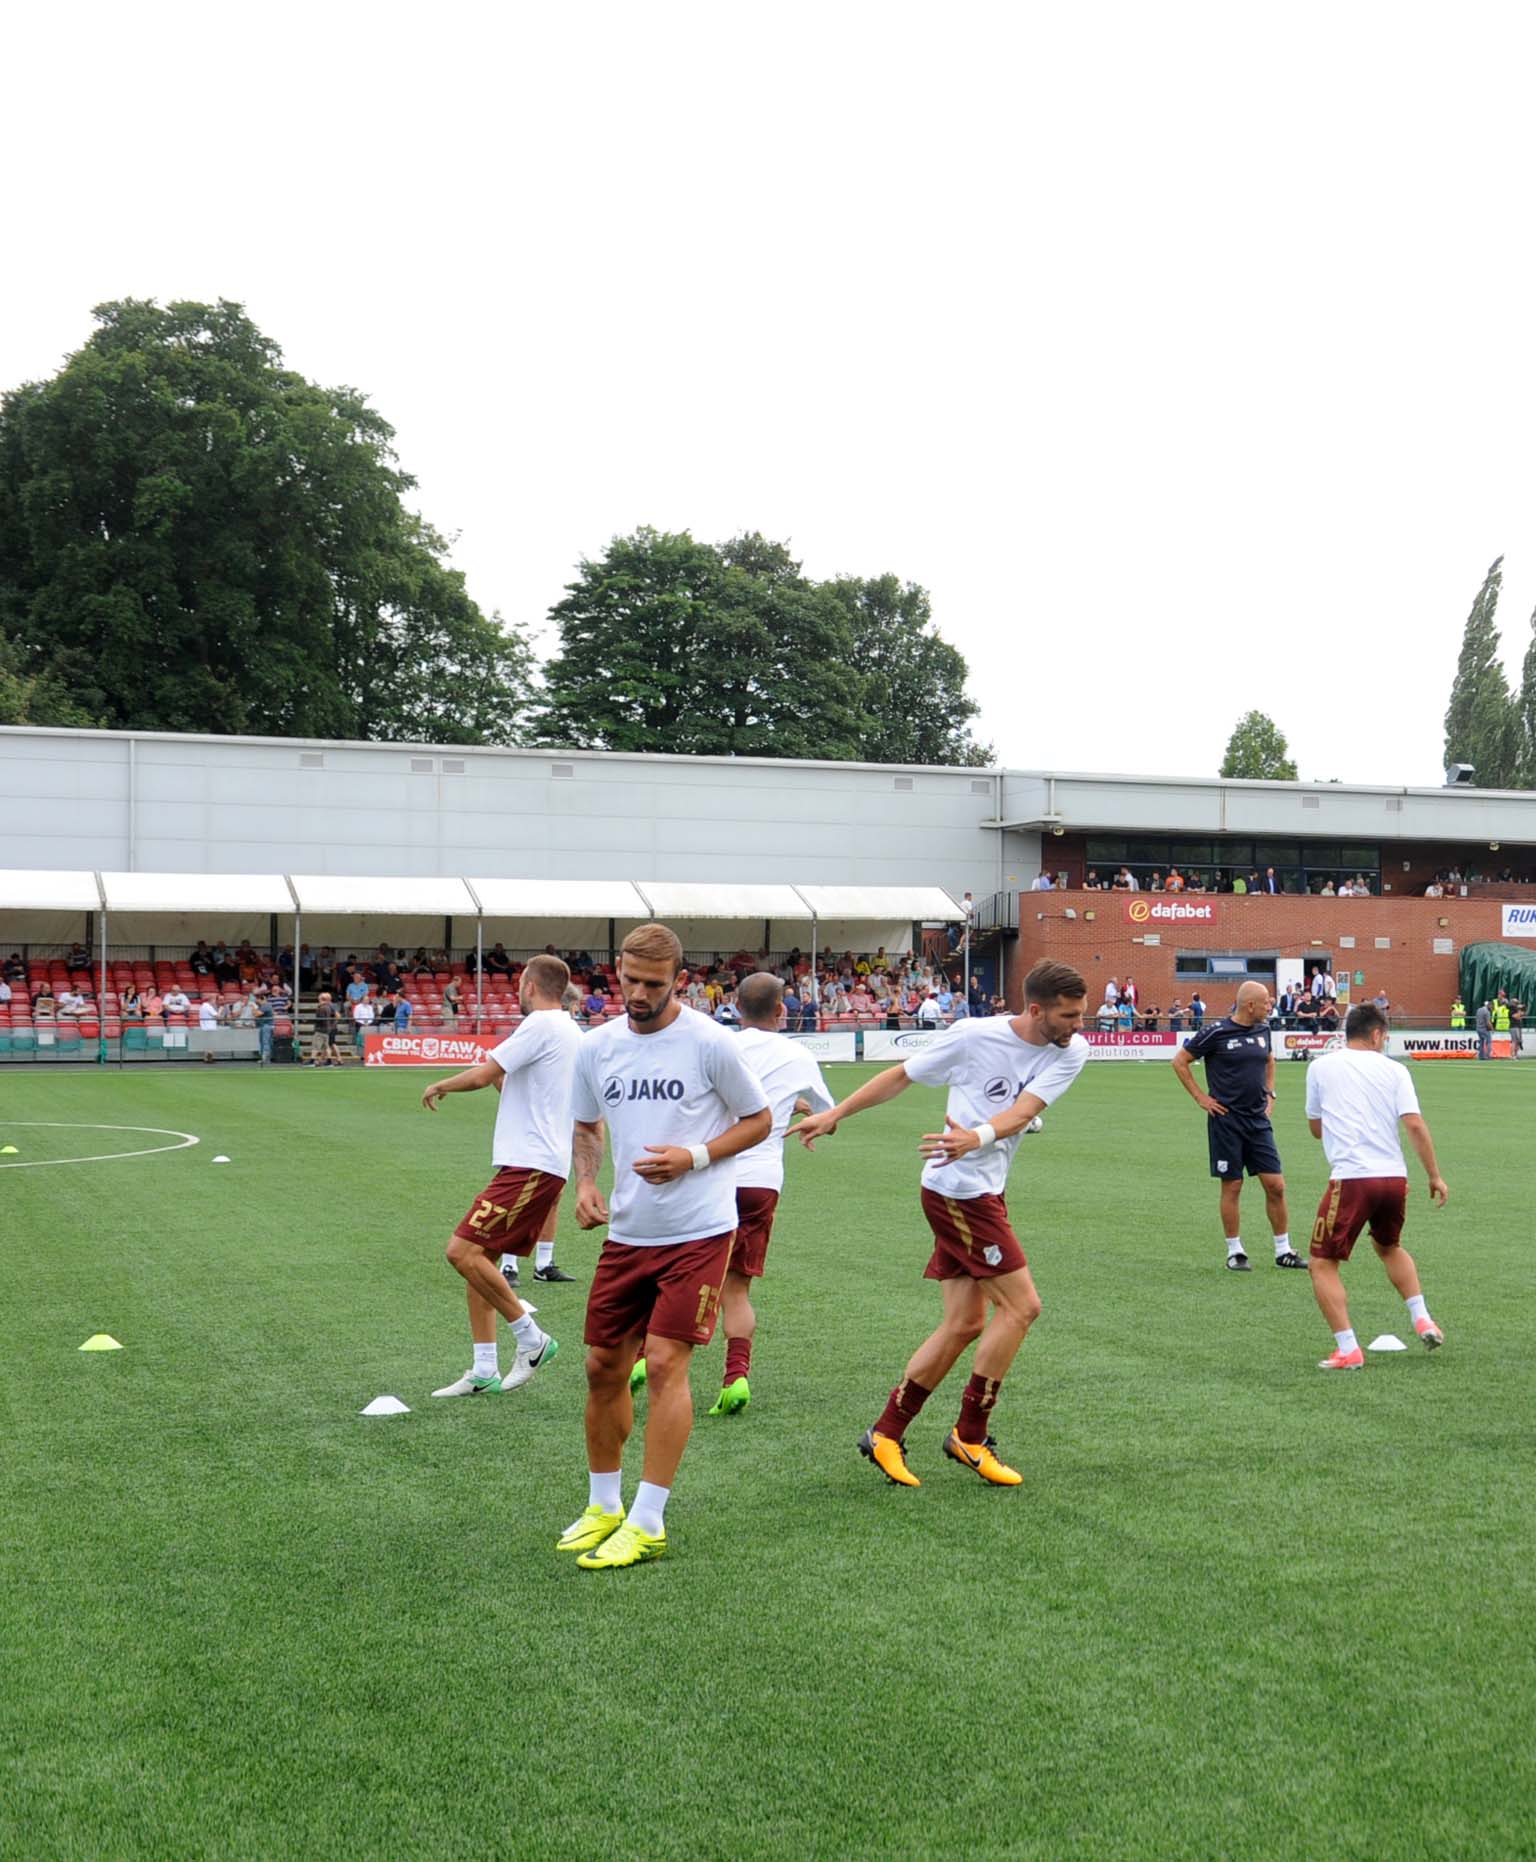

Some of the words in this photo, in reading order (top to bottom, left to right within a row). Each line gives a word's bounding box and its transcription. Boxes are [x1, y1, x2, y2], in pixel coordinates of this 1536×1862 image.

[1151, 902, 1212, 920] dafabet
[382, 1037, 421, 1050] CBDC
[440, 1040, 476, 1053] FAW
[628, 1079, 685, 1100] JAKO
[469, 1200, 507, 1232] 27
